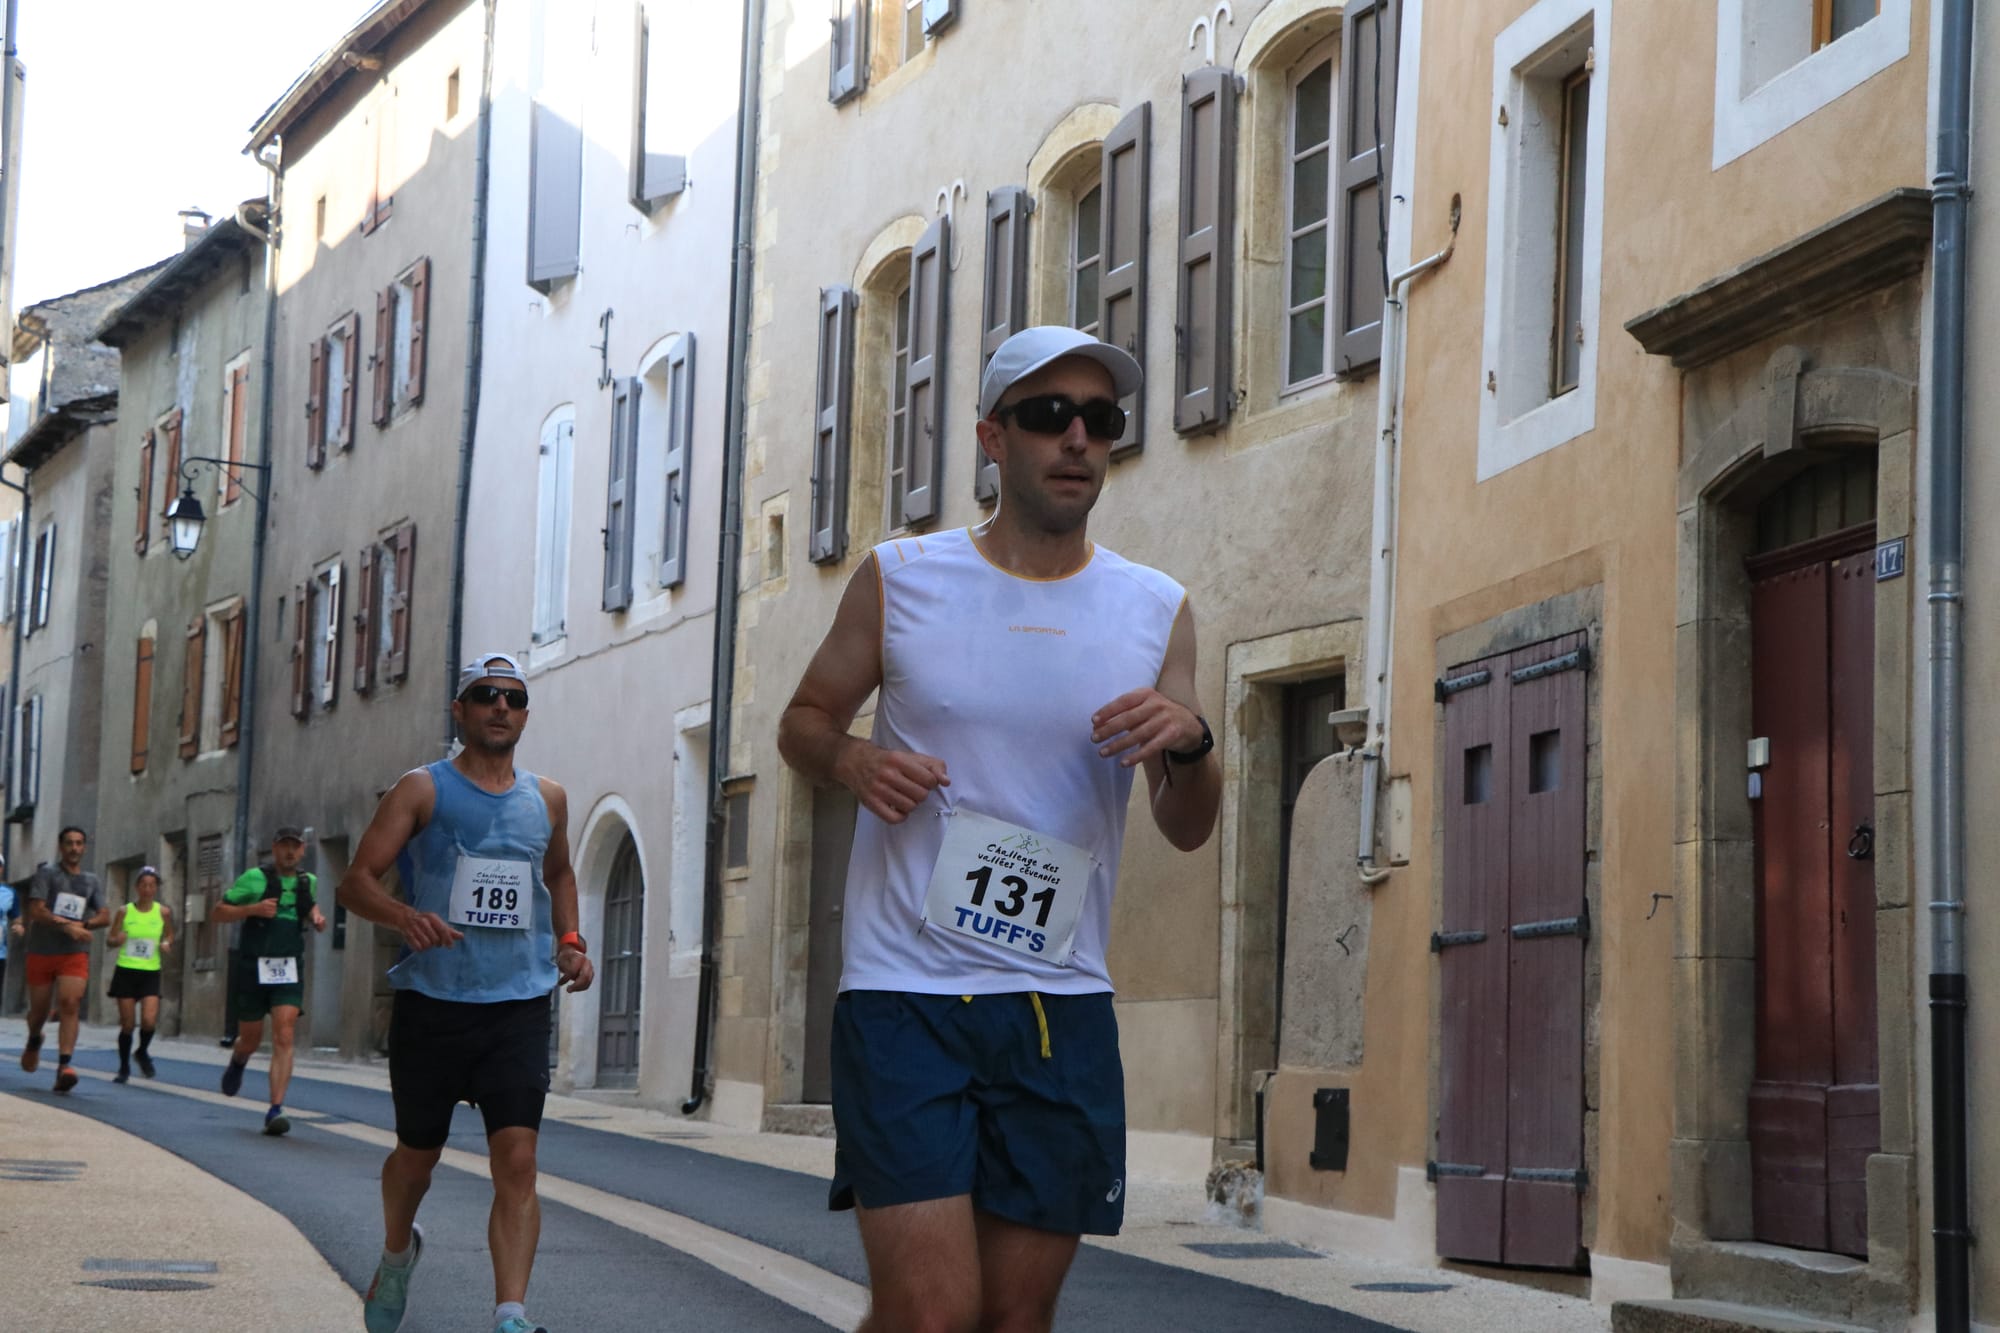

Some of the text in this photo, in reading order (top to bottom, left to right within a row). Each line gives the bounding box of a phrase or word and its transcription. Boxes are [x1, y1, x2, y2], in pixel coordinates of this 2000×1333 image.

[1881, 546, 1898, 573] 17
[978, 853, 1061, 885] vallées cévenoles
[987, 844, 1059, 873] Challenge des
[472, 886, 518, 911] 189
[966, 865, 1056, 928] 131
[465, 911, 519, 926] TUFF'S
[955, 906, 1046, 953] TUFF'S
[270, 968, 286, 978] 38
